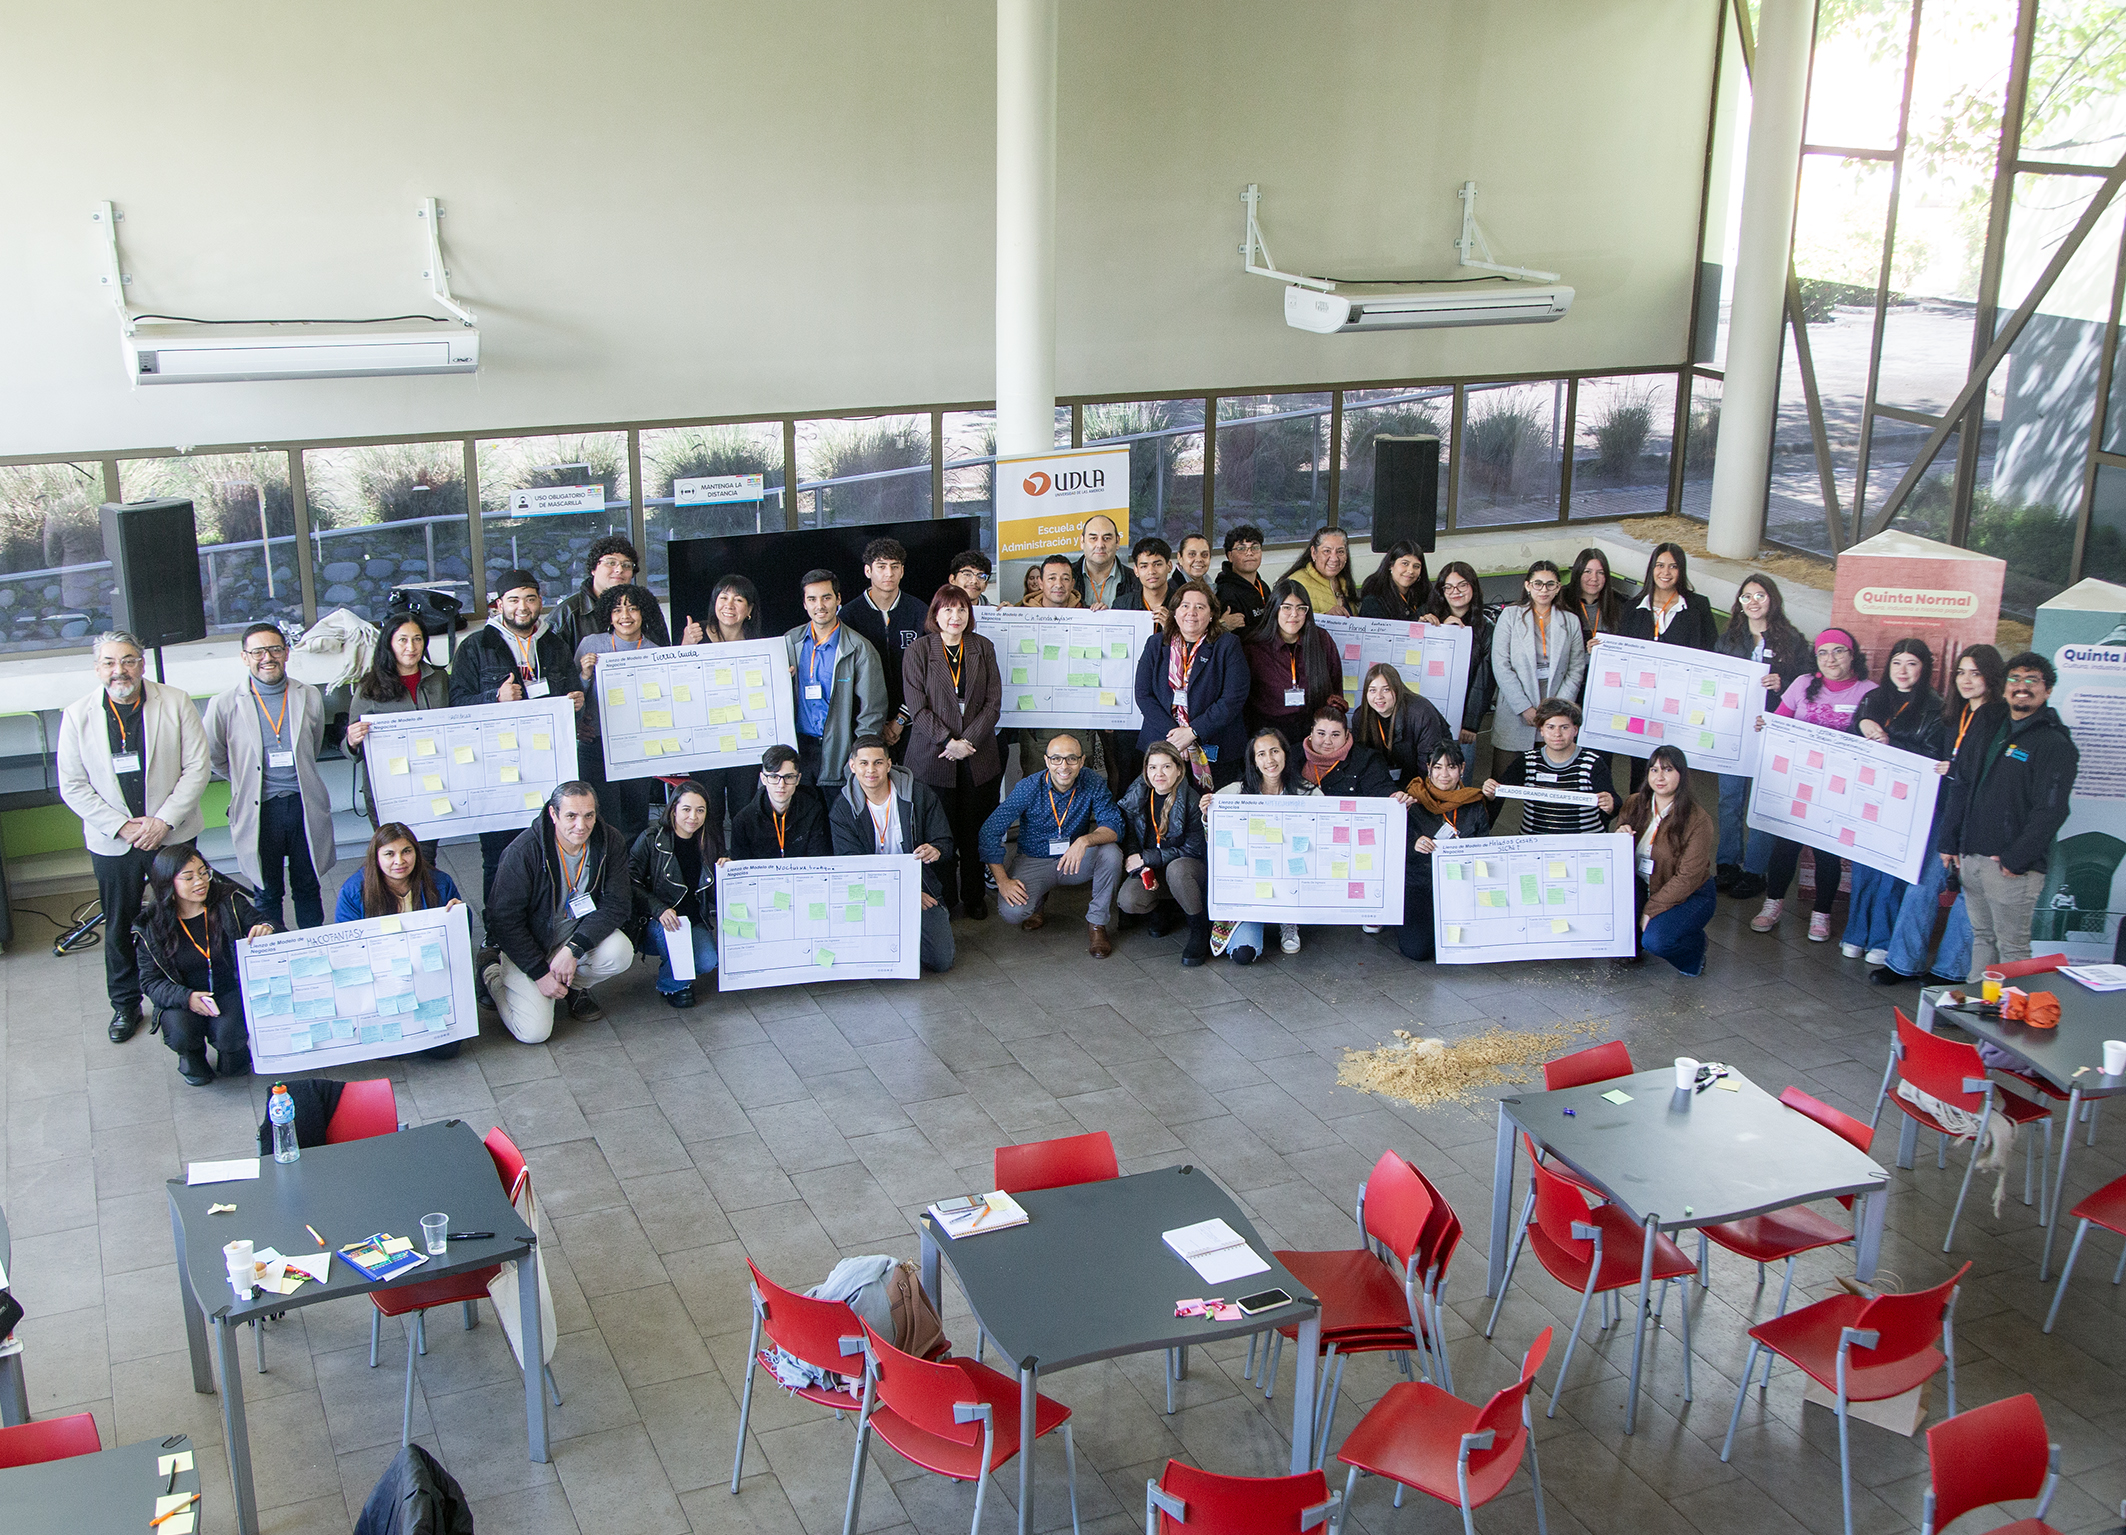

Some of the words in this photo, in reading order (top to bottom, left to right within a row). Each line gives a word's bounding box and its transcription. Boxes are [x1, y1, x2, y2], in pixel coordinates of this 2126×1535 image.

[1054, 469, 1104, 492] UDLA
[707, 490, 738, 498] DISTANCIA
[1038, 522, 1075, 535] Escuela
[1002, 536, 1072, 553] Administración
[1072, 536, 1079, 546] y
[1862, 591, 1913, 604] Quinta
[1915, 594, 1972, 607] Normal
[2064, 649, 2120, 662] Quinta
[1523, 790, 1549, 798] GRANDPA
